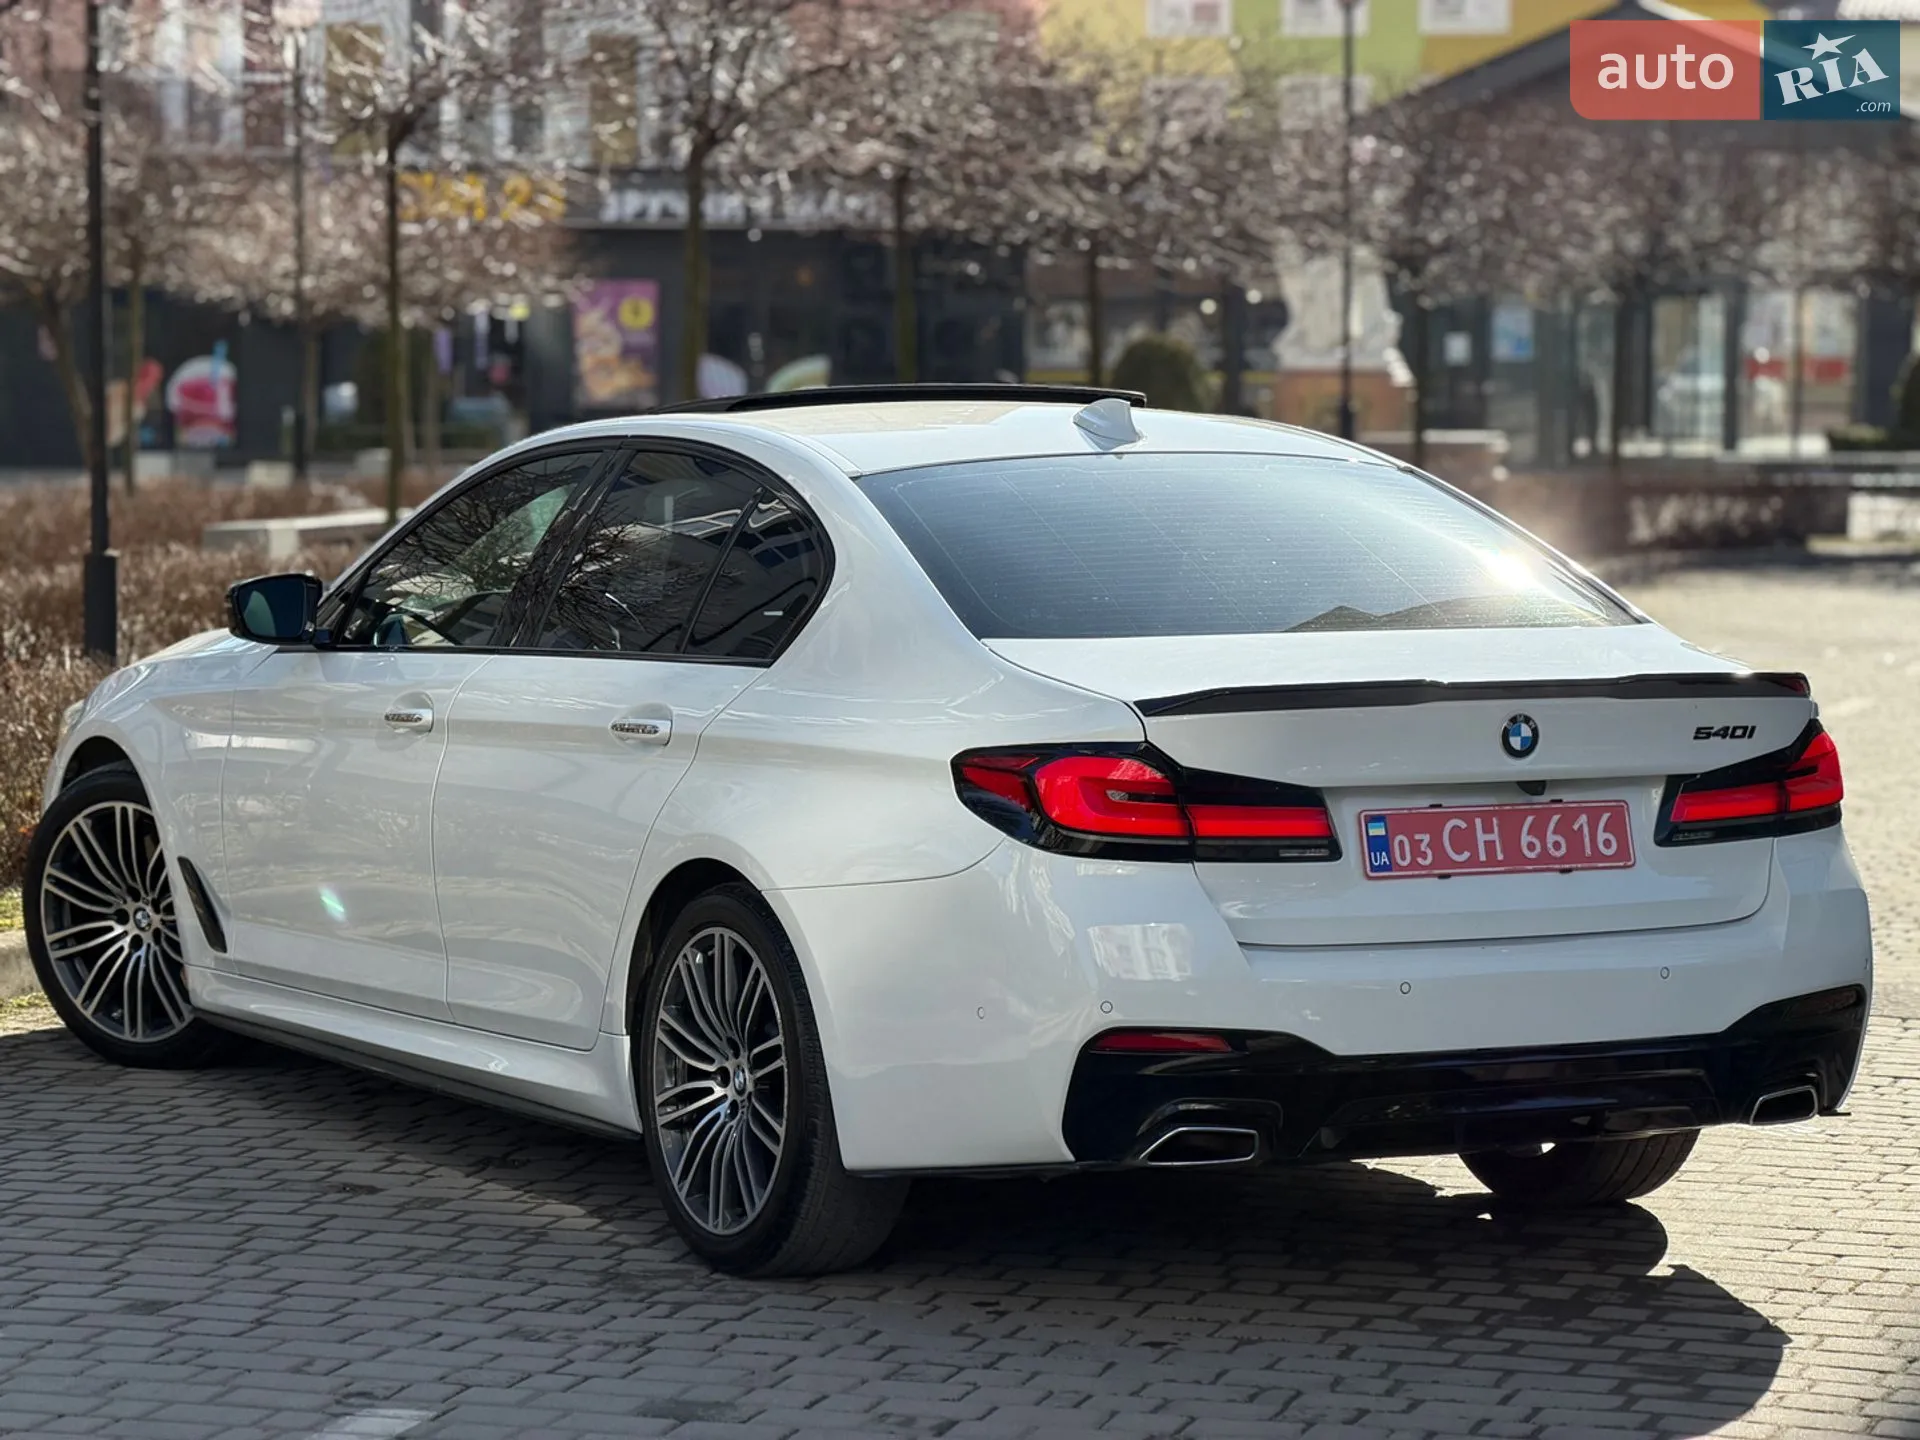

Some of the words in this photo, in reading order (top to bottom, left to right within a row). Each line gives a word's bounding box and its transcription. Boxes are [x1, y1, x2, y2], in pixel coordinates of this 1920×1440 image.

[1393, 833, 1433, 867] 03
[1442, 816, 1504, 862] CH
[1520, 812, 1618, 859] 6616
[1371, 851, 1390, 866] UA
